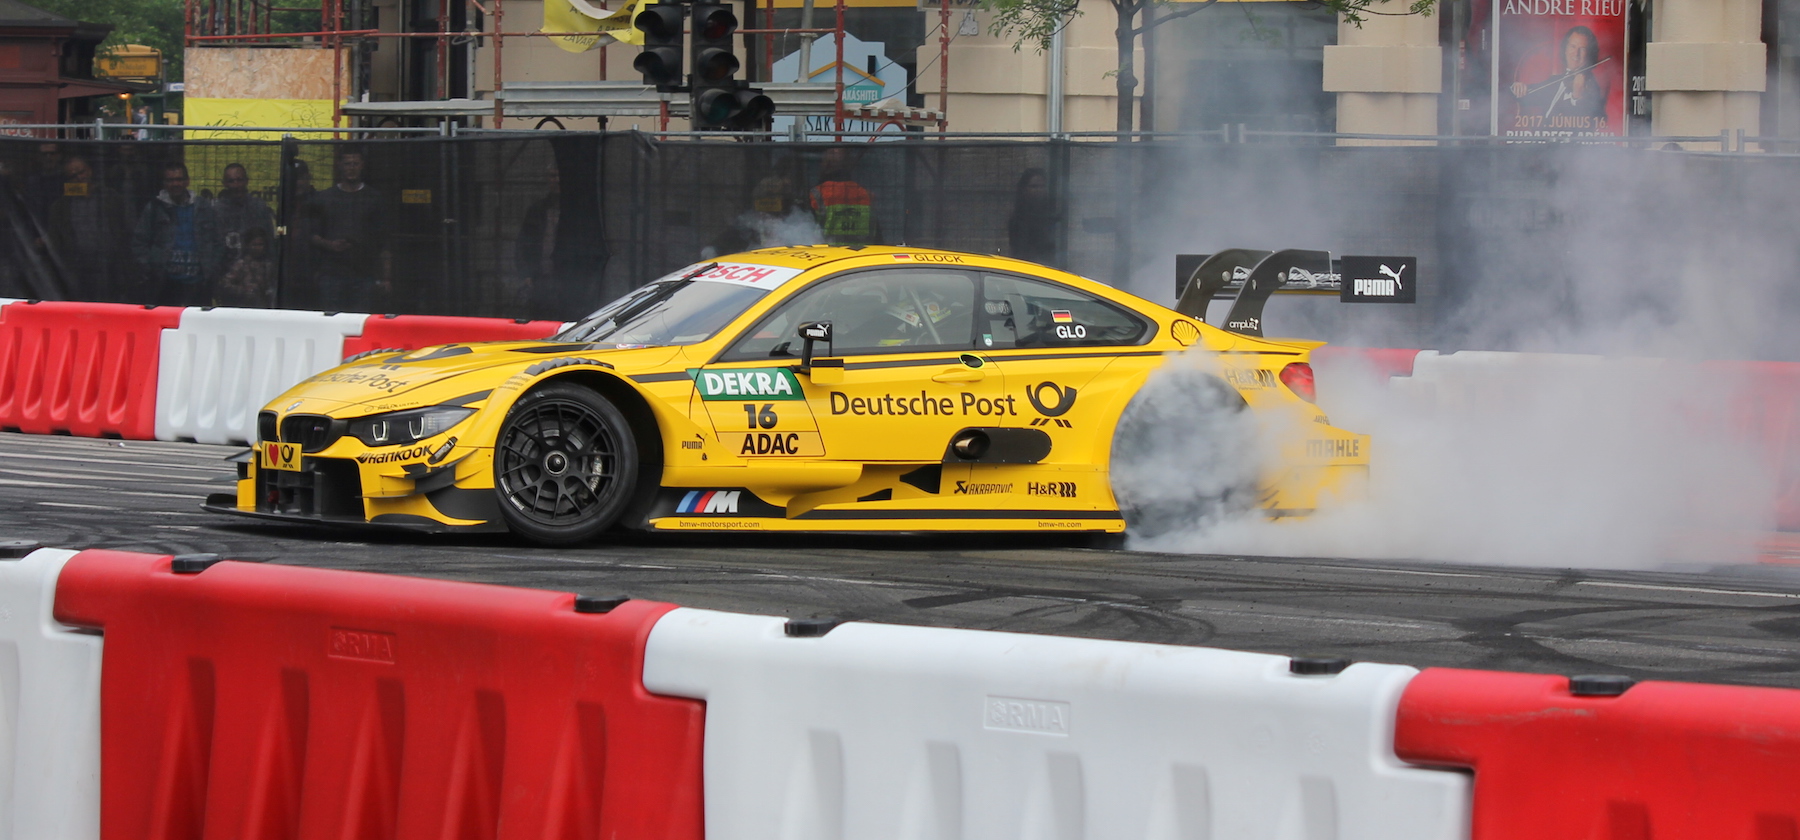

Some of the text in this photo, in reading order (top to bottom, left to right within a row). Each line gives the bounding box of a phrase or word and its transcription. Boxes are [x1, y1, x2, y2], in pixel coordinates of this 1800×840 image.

[1581, 0, 1622, 16] RIEU
[842, 88, 879, 101] AKÁSHITEL
[1515, 113, 1608, 129] 2017. JÚNIUS 16.
[914, 254, 964, 264] GLOCK
[1354, 279, 1395, 296] PUMA
[1056, 325, 1087, 339] GLO
[704, 372, 793, 396] DEKRA
[830, 390, 1017, 416] Deutsche Post
[743, 404, 778, 429] 16
[682, 441, 703, 450] PUMA
[741, 433, 799, 455] ADAC
[1306, 439, 1359, 457] MAHLE
[1027, 482, 1057, 495] H&R
[679, 519, 760, 529] bmw-motorsport.com
